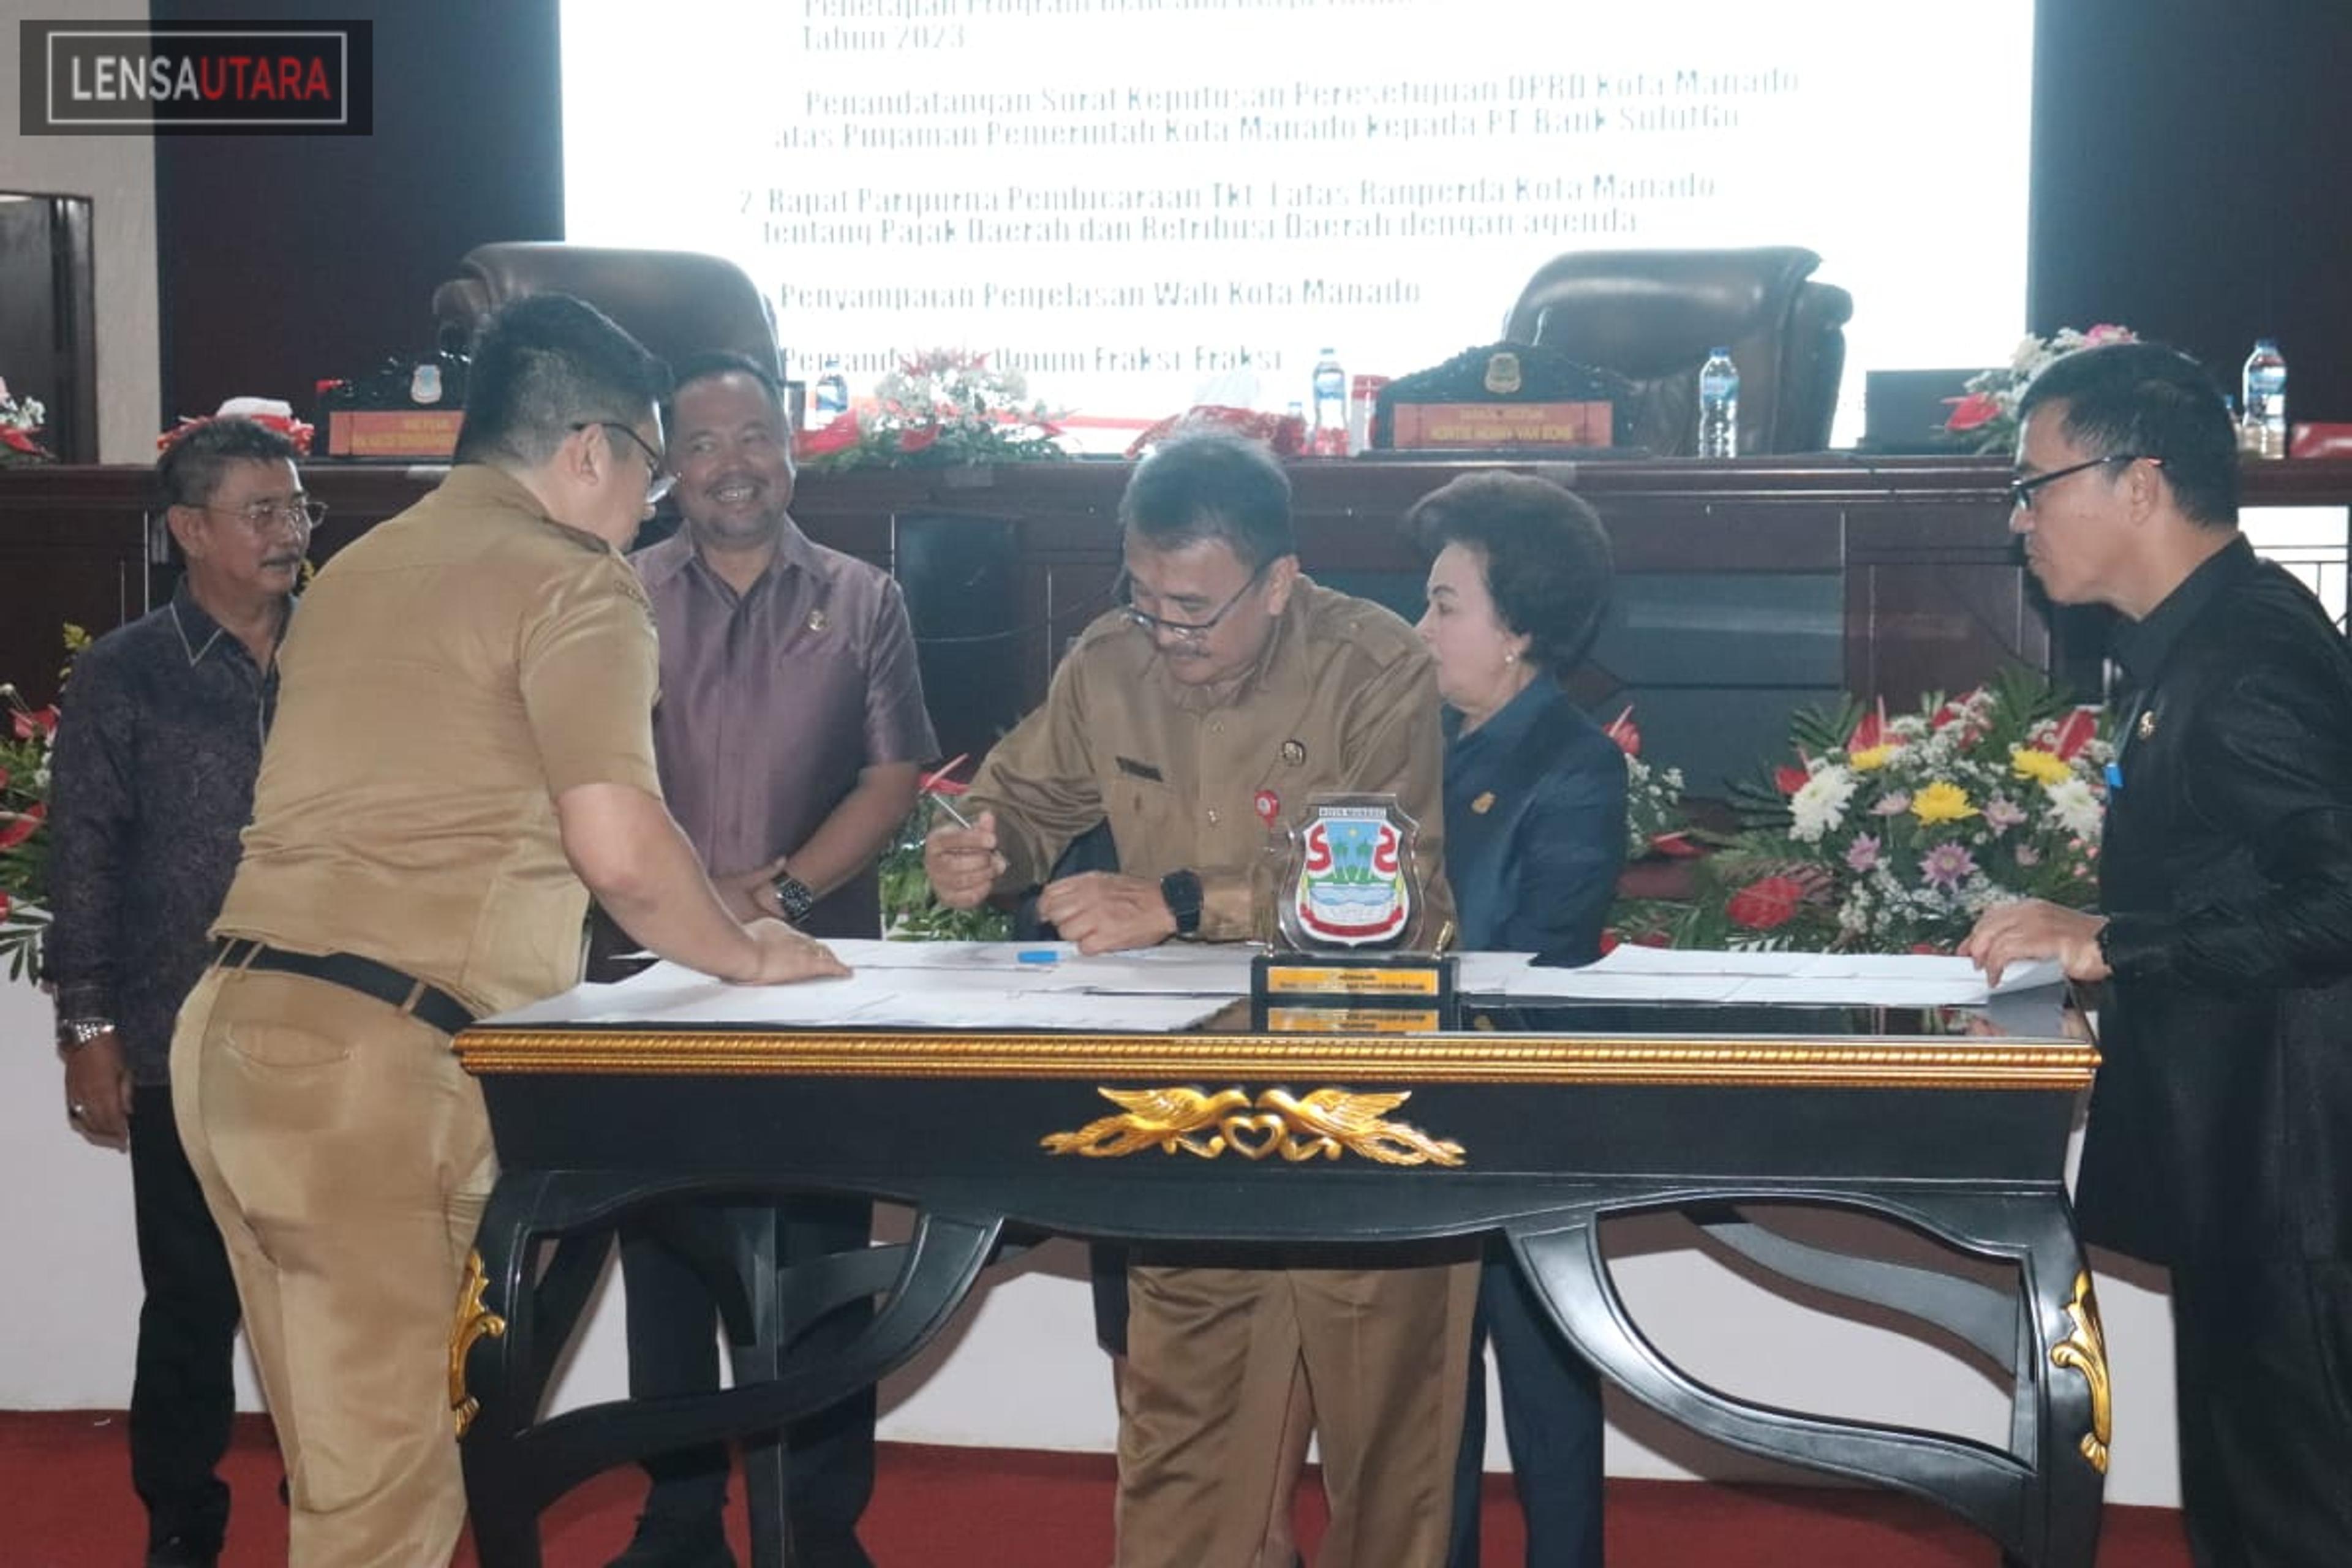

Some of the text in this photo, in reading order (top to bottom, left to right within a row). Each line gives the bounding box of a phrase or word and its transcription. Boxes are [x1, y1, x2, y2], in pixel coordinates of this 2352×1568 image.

[804, 24, 964, 51] Tahun 2023
[1042, 88, 1115, 111] Surat
[1128, 86, 1284, 113] Keputusan
[1508, 74, 1585, 100] DPRD
[1597, 74, 1663, 97] Kota
[1676, 67, 1798, 94] Manado
[776, 126, 832, 148] atas
[1166, 119, 1227, 142] Kota
[1240, 115, 1355, 141] Manado
[1366, 110, 1475, 141] kepada
[1535, 108, 1606, 134] Bank
[769, 189, 846, 216] Rapat
[1213, 183, 1251, 208] Tkt
[1515, 176, 1582, 202] Kota
[1593, 173, 1714, 199] Manado
[764, 221, 870, 245] tentang
[882, 218, 956, 246] Pajak
[968, 217, 1069, 243] Daerah
[1080, 217, 1130, 241] dan
[1286, 212, 1389, 239] Daerah
[1401, 207, 1513, 236] dengan
[1525, 207, 1636, 235] agenda
[1155, 282, 1217, 306] Wali
[1229, 282, 1292, 305] Kota
[1303, 279, 1420, 304] Manado
[1095, 347, 1180, 371] Fraksi
